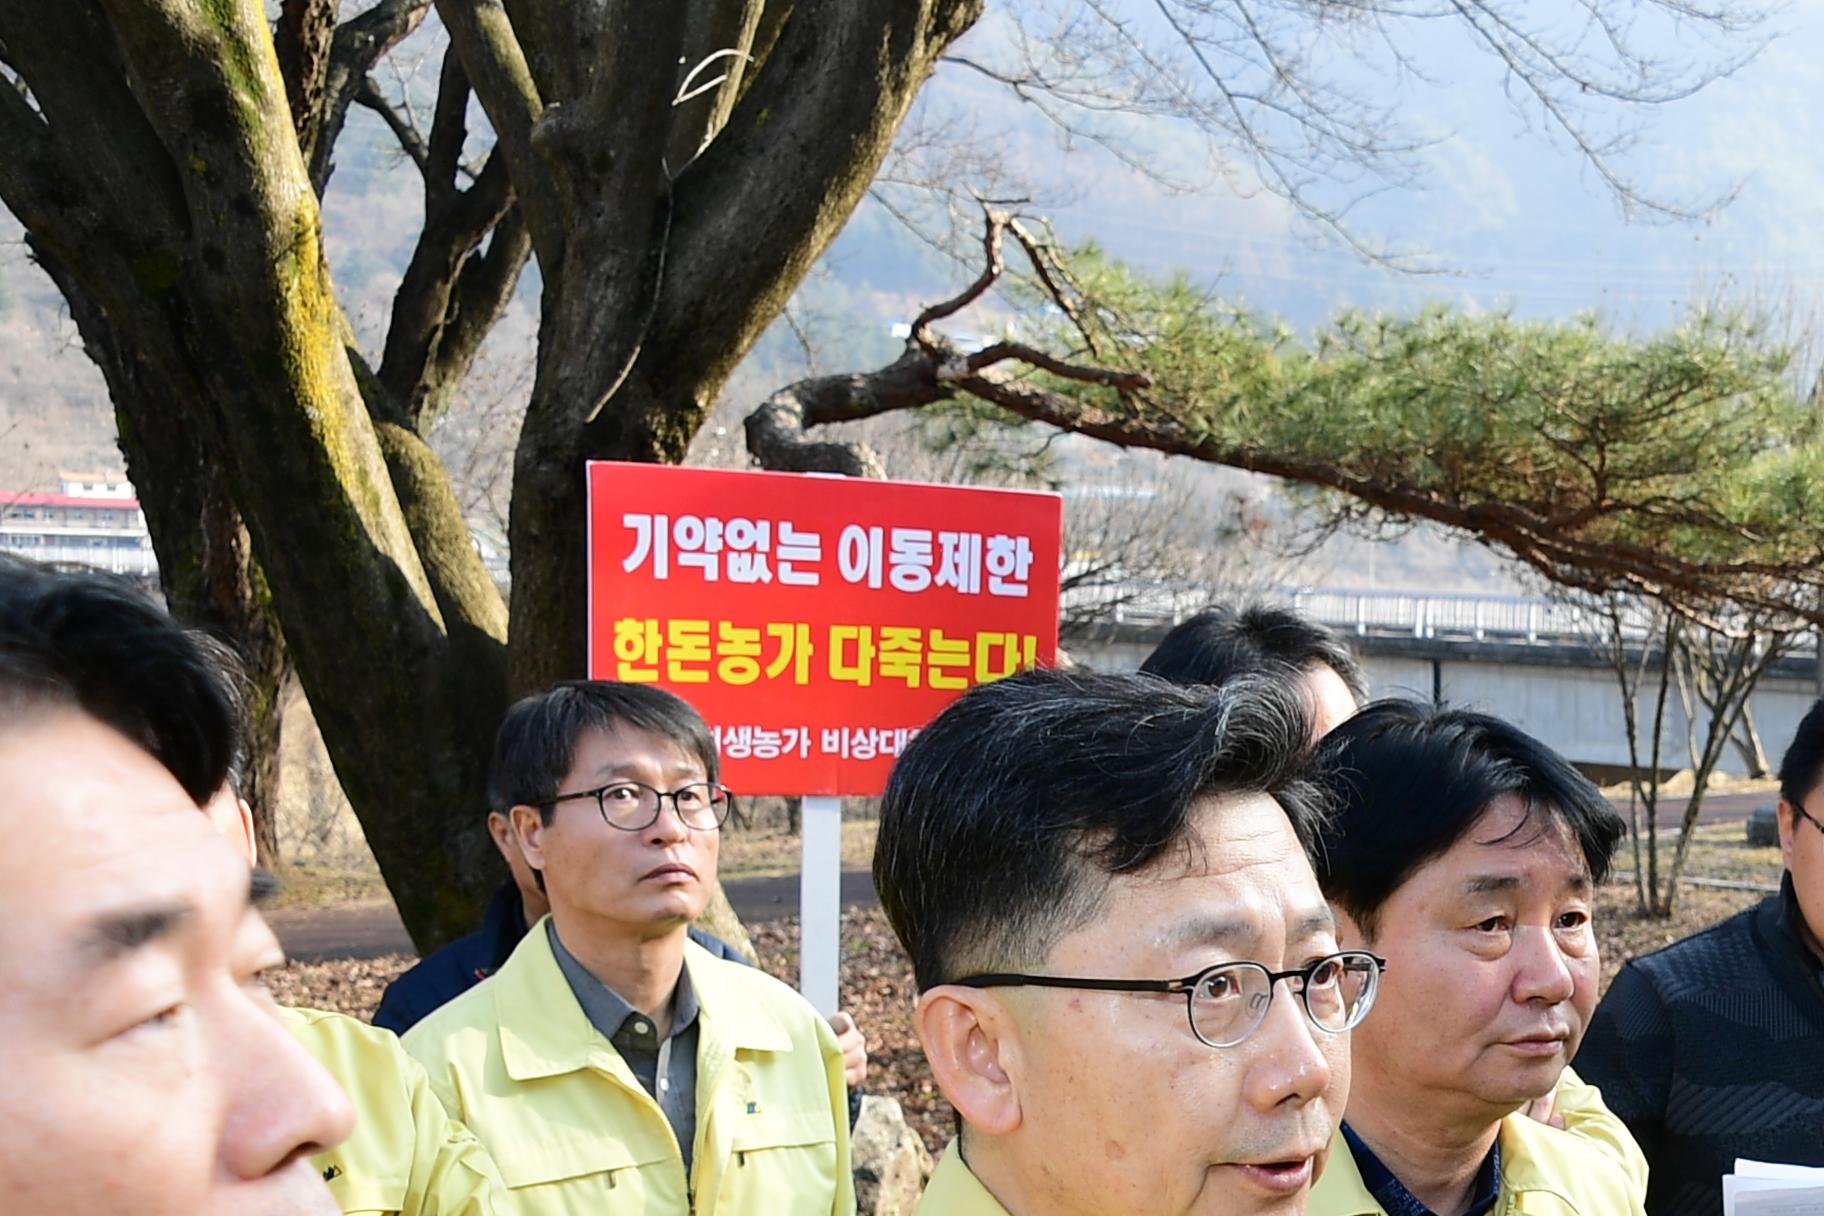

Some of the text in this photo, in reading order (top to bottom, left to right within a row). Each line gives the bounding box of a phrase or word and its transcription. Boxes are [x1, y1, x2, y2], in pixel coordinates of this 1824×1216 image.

[622, 514, 1033, 597] 기약없는 이동제한
[613, 617, 1037, 690] 한돈농가 다죽는다!
[821, 726, 922, 760] 비상대
